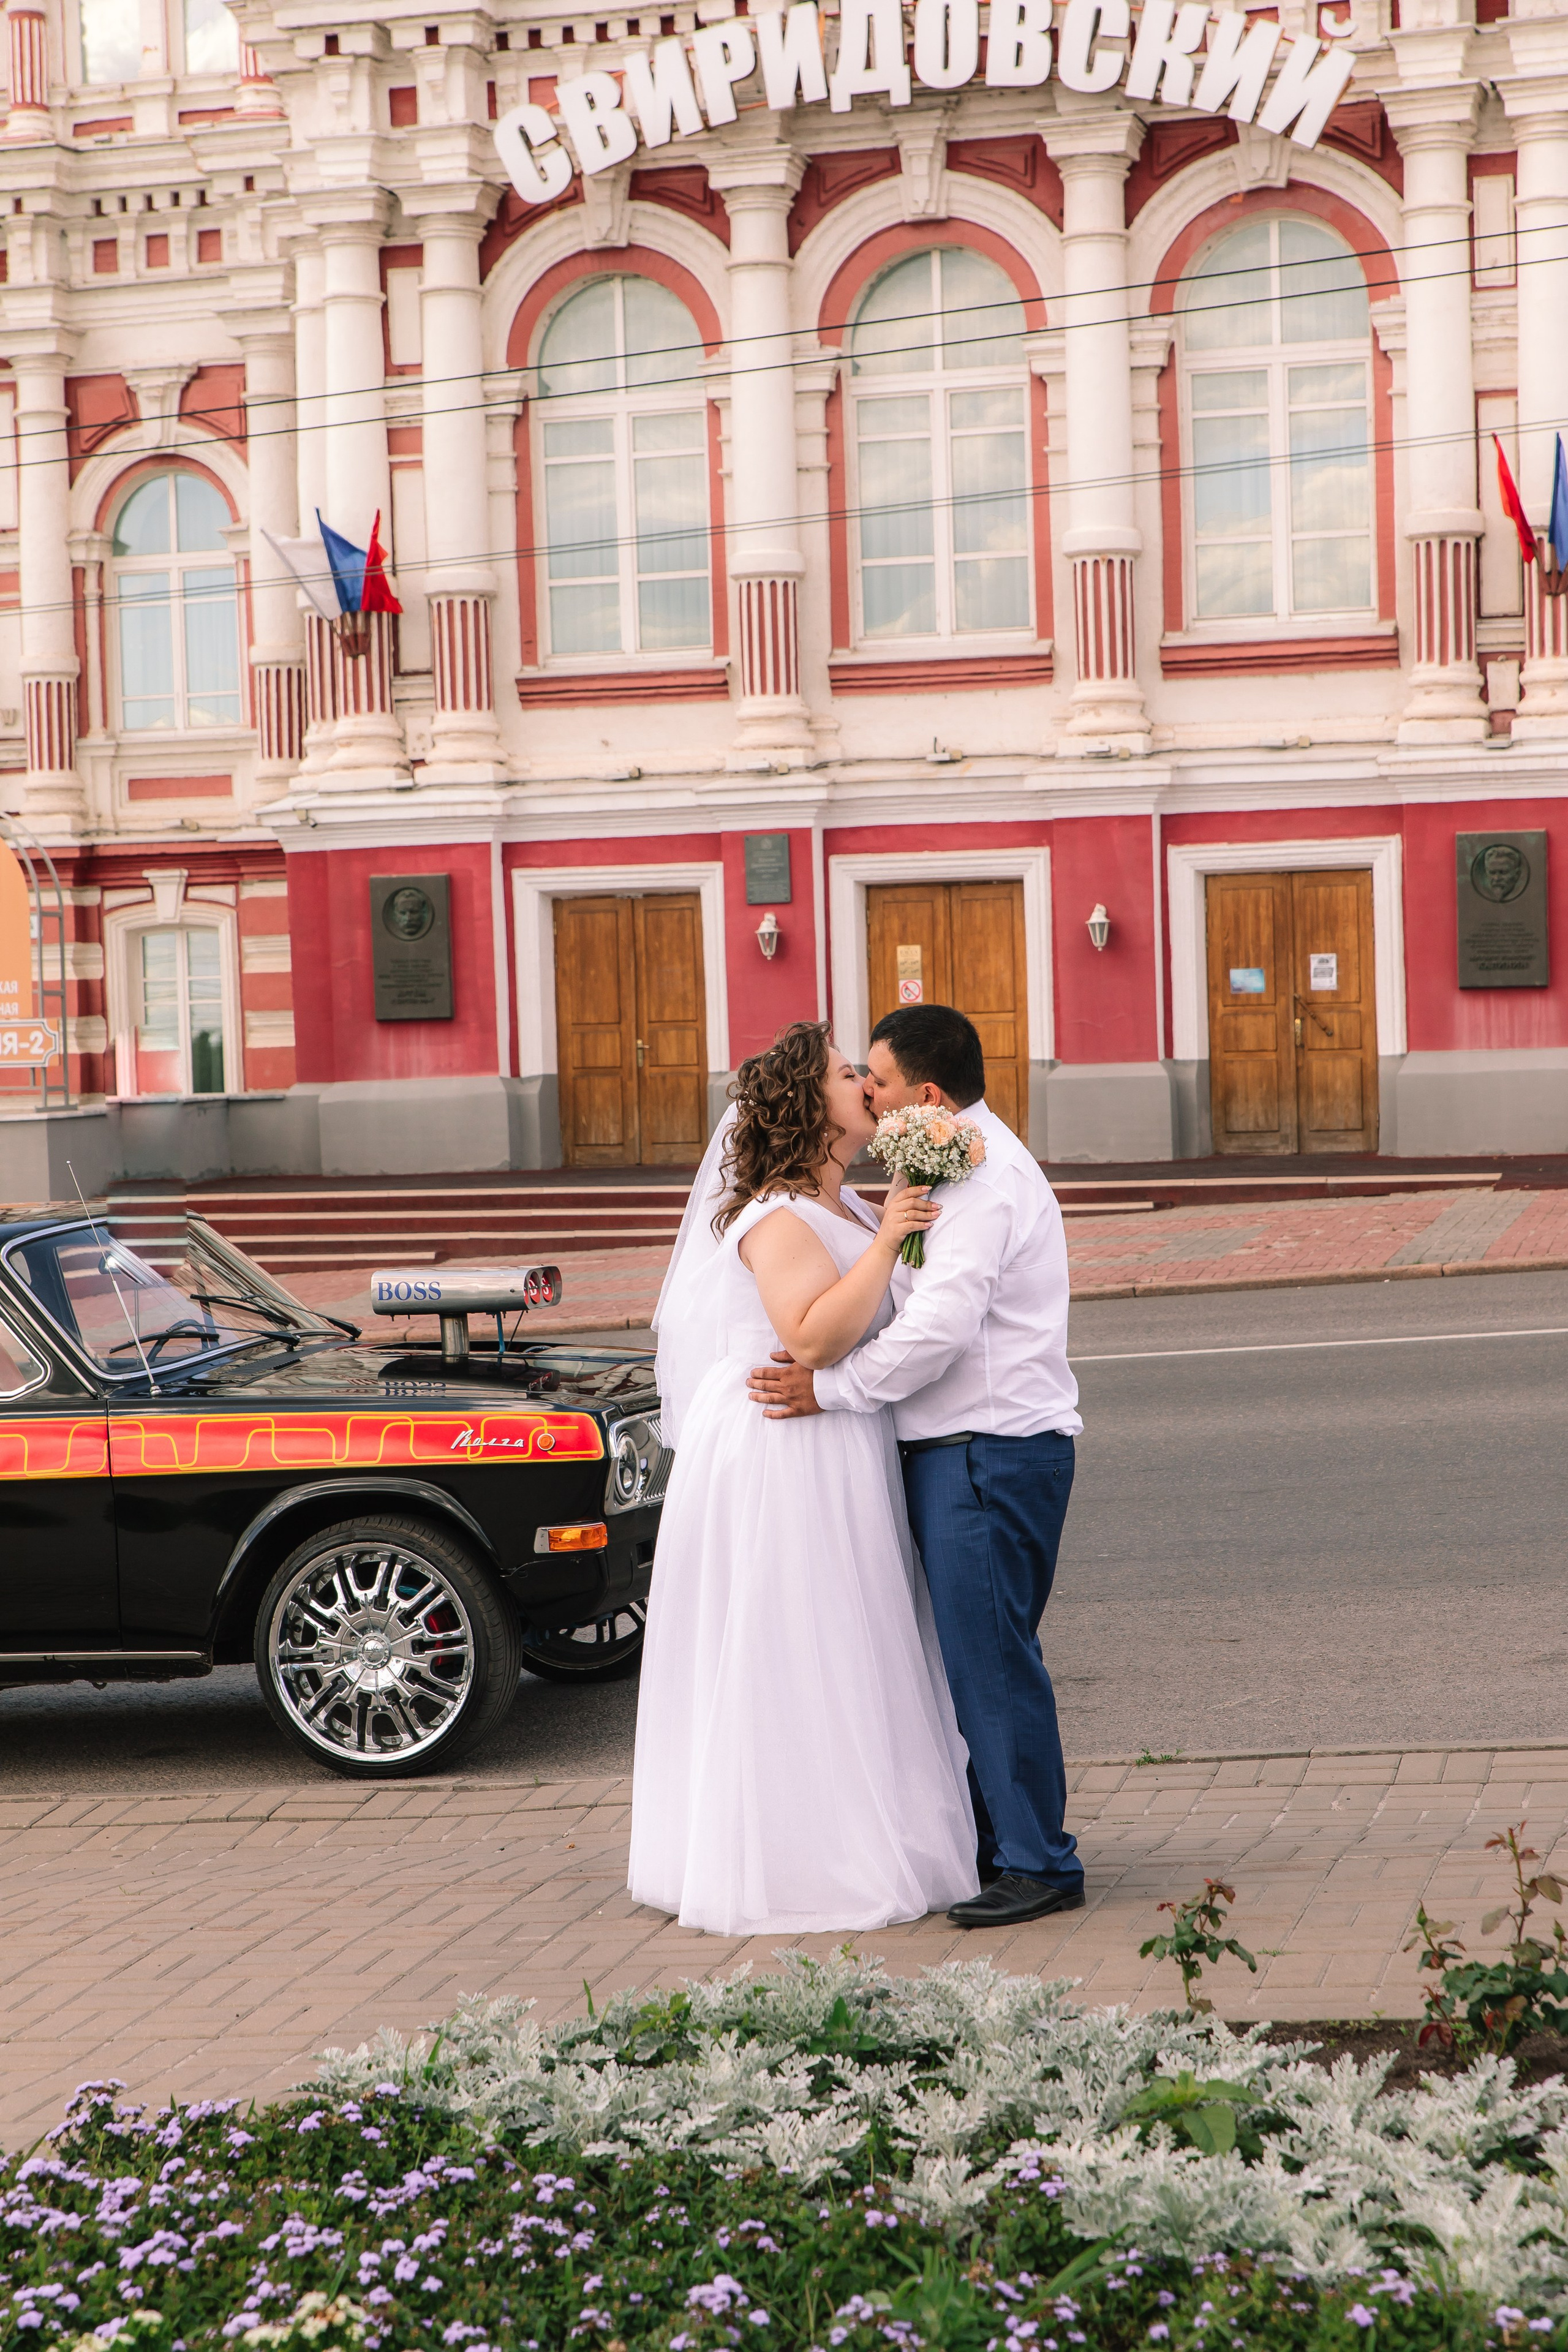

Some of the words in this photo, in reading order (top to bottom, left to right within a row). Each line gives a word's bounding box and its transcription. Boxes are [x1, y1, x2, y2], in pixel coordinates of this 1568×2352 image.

[493, 0, 1357, 204] СВИРИДОВСКИЙ
[0, 1030, 45, 1056] Я-2
[377, 1281, 442, 1301] BOSS
